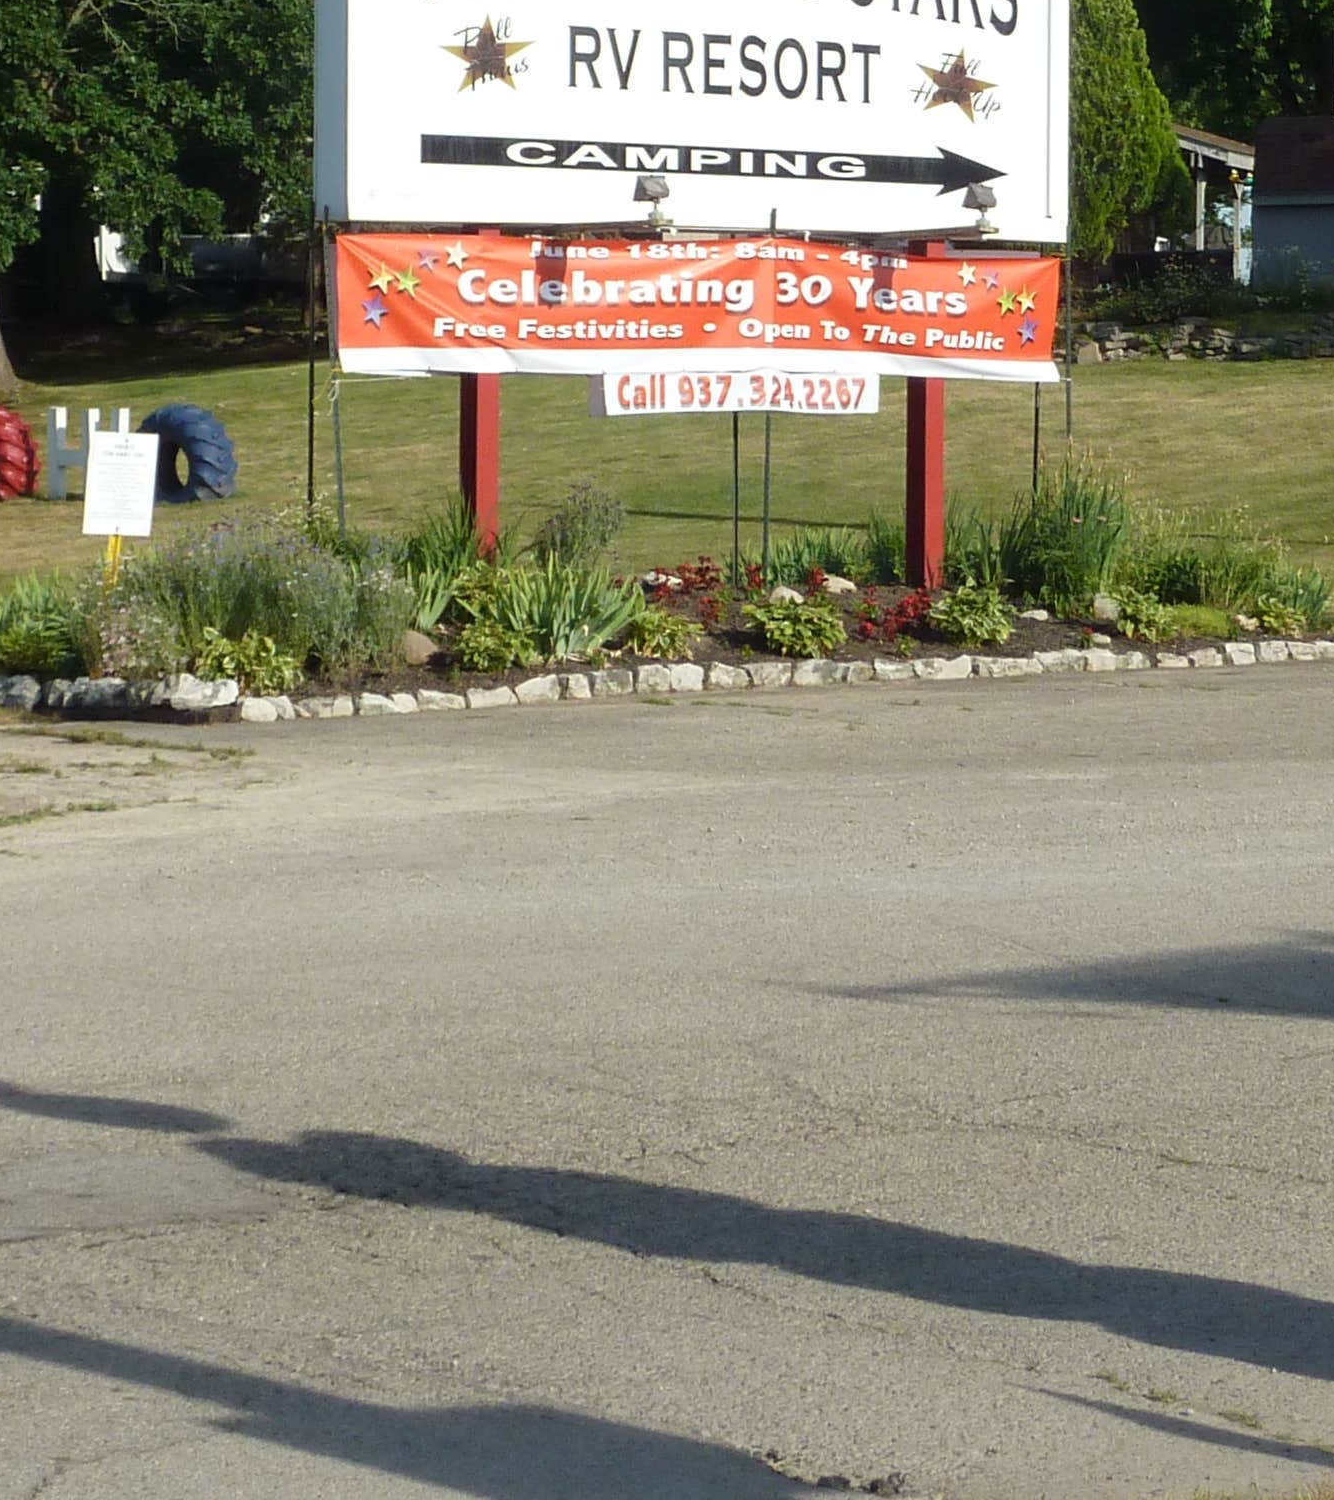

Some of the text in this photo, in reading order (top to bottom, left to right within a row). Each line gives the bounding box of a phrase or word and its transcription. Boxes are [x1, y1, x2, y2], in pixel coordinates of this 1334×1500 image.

[453, 16, 512, 55] Pll
[568, 25, 881, 104] RV RESORT
[505, 141, 867, 179] CAMPING
[528, 240, 610, 259] June
[627, 242, 720, 260] 18th:
[733, 242, 805, 262] 8am
[839, 250, 908, 271] 4pm
[457, 269, 968, 315] Celebrating 30 Years
[433, 317, 1006, 351] Free Festivities Open To The Public
[617, 374, 666, 410] Call
